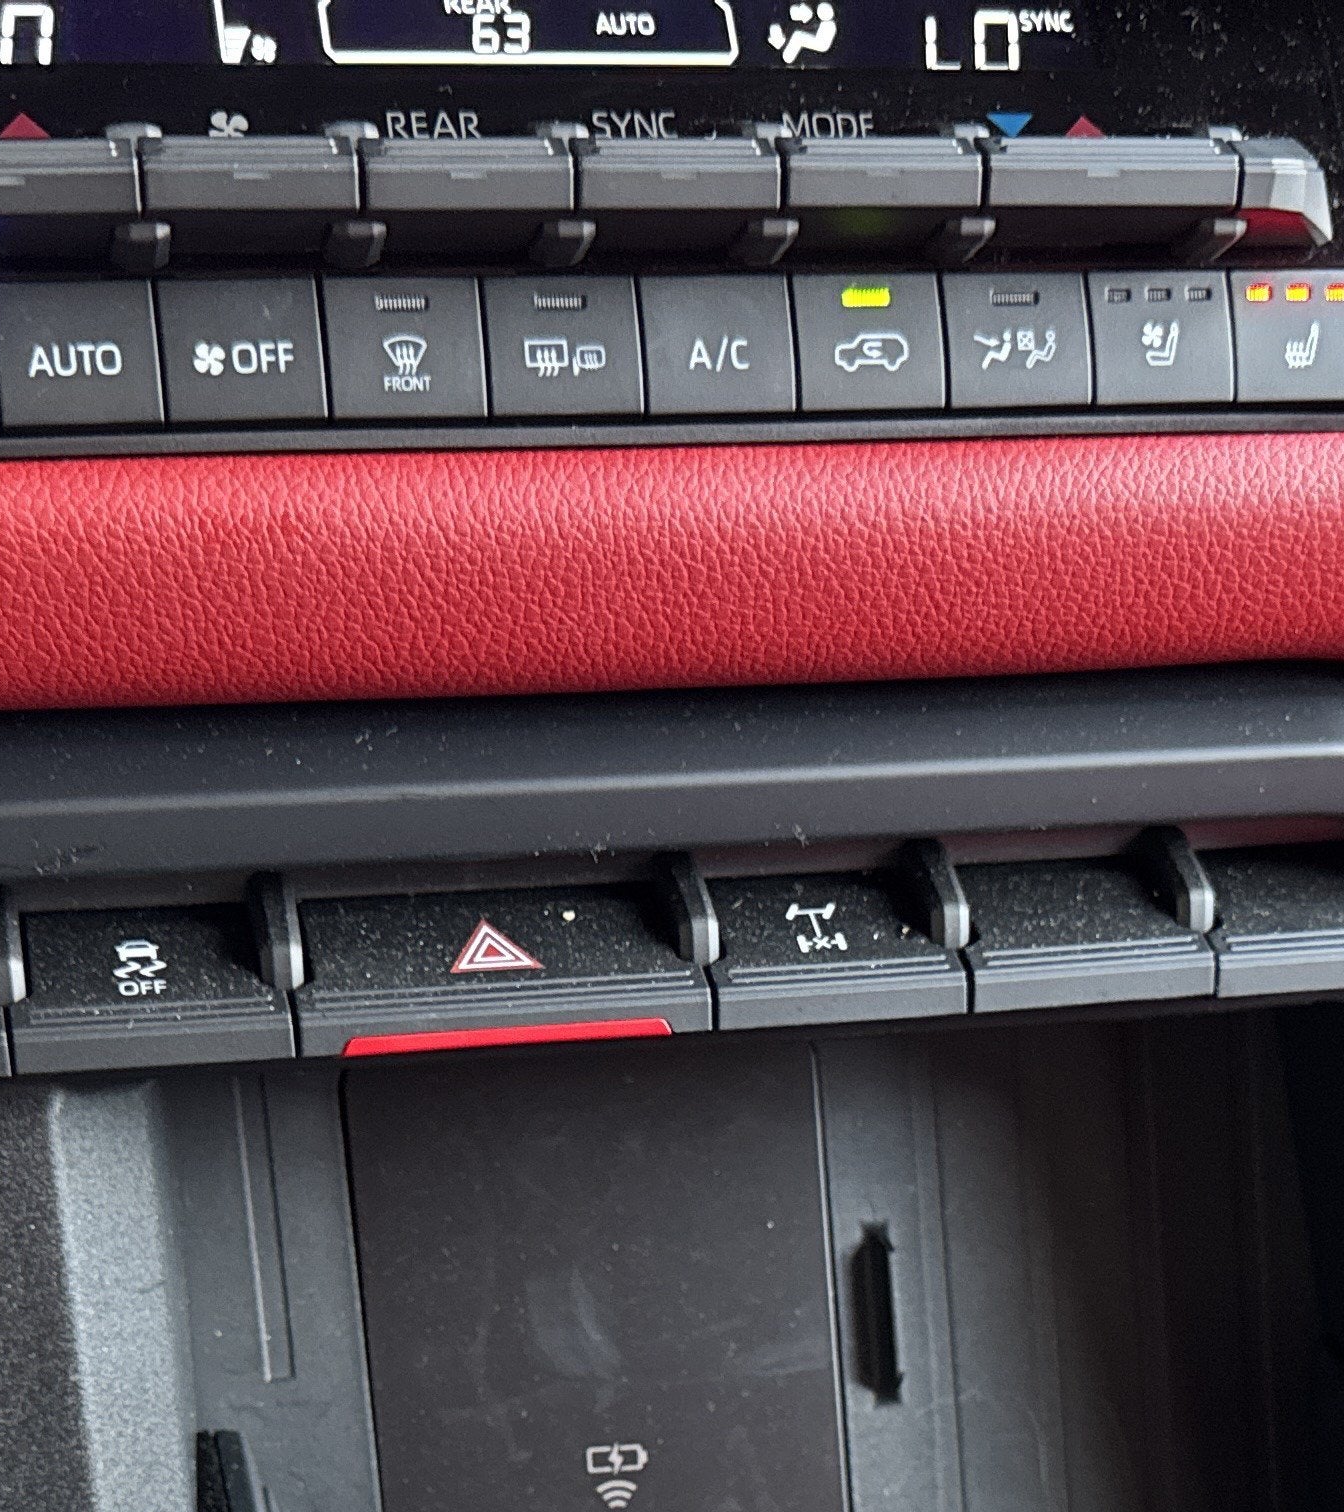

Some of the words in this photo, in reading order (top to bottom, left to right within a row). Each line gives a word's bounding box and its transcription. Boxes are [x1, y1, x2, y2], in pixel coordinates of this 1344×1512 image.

[471, 12, 531, 54] 63
[595, 11, 656, 36] AUTO
[1019, 9, 1075, 33] SYNC
[385, 111, 482, 138] REAR
[592, 111, 678, 138] SYNC
[782, 111, 874, 138] MODE
[28, 342, 123, 378] AUTO
[232, 341, 295, 376] OFF
[688, 335, 751, 373] A/C
[382, 375, 432, 393] FRONT
[117, 979, 168, 997] OFF
